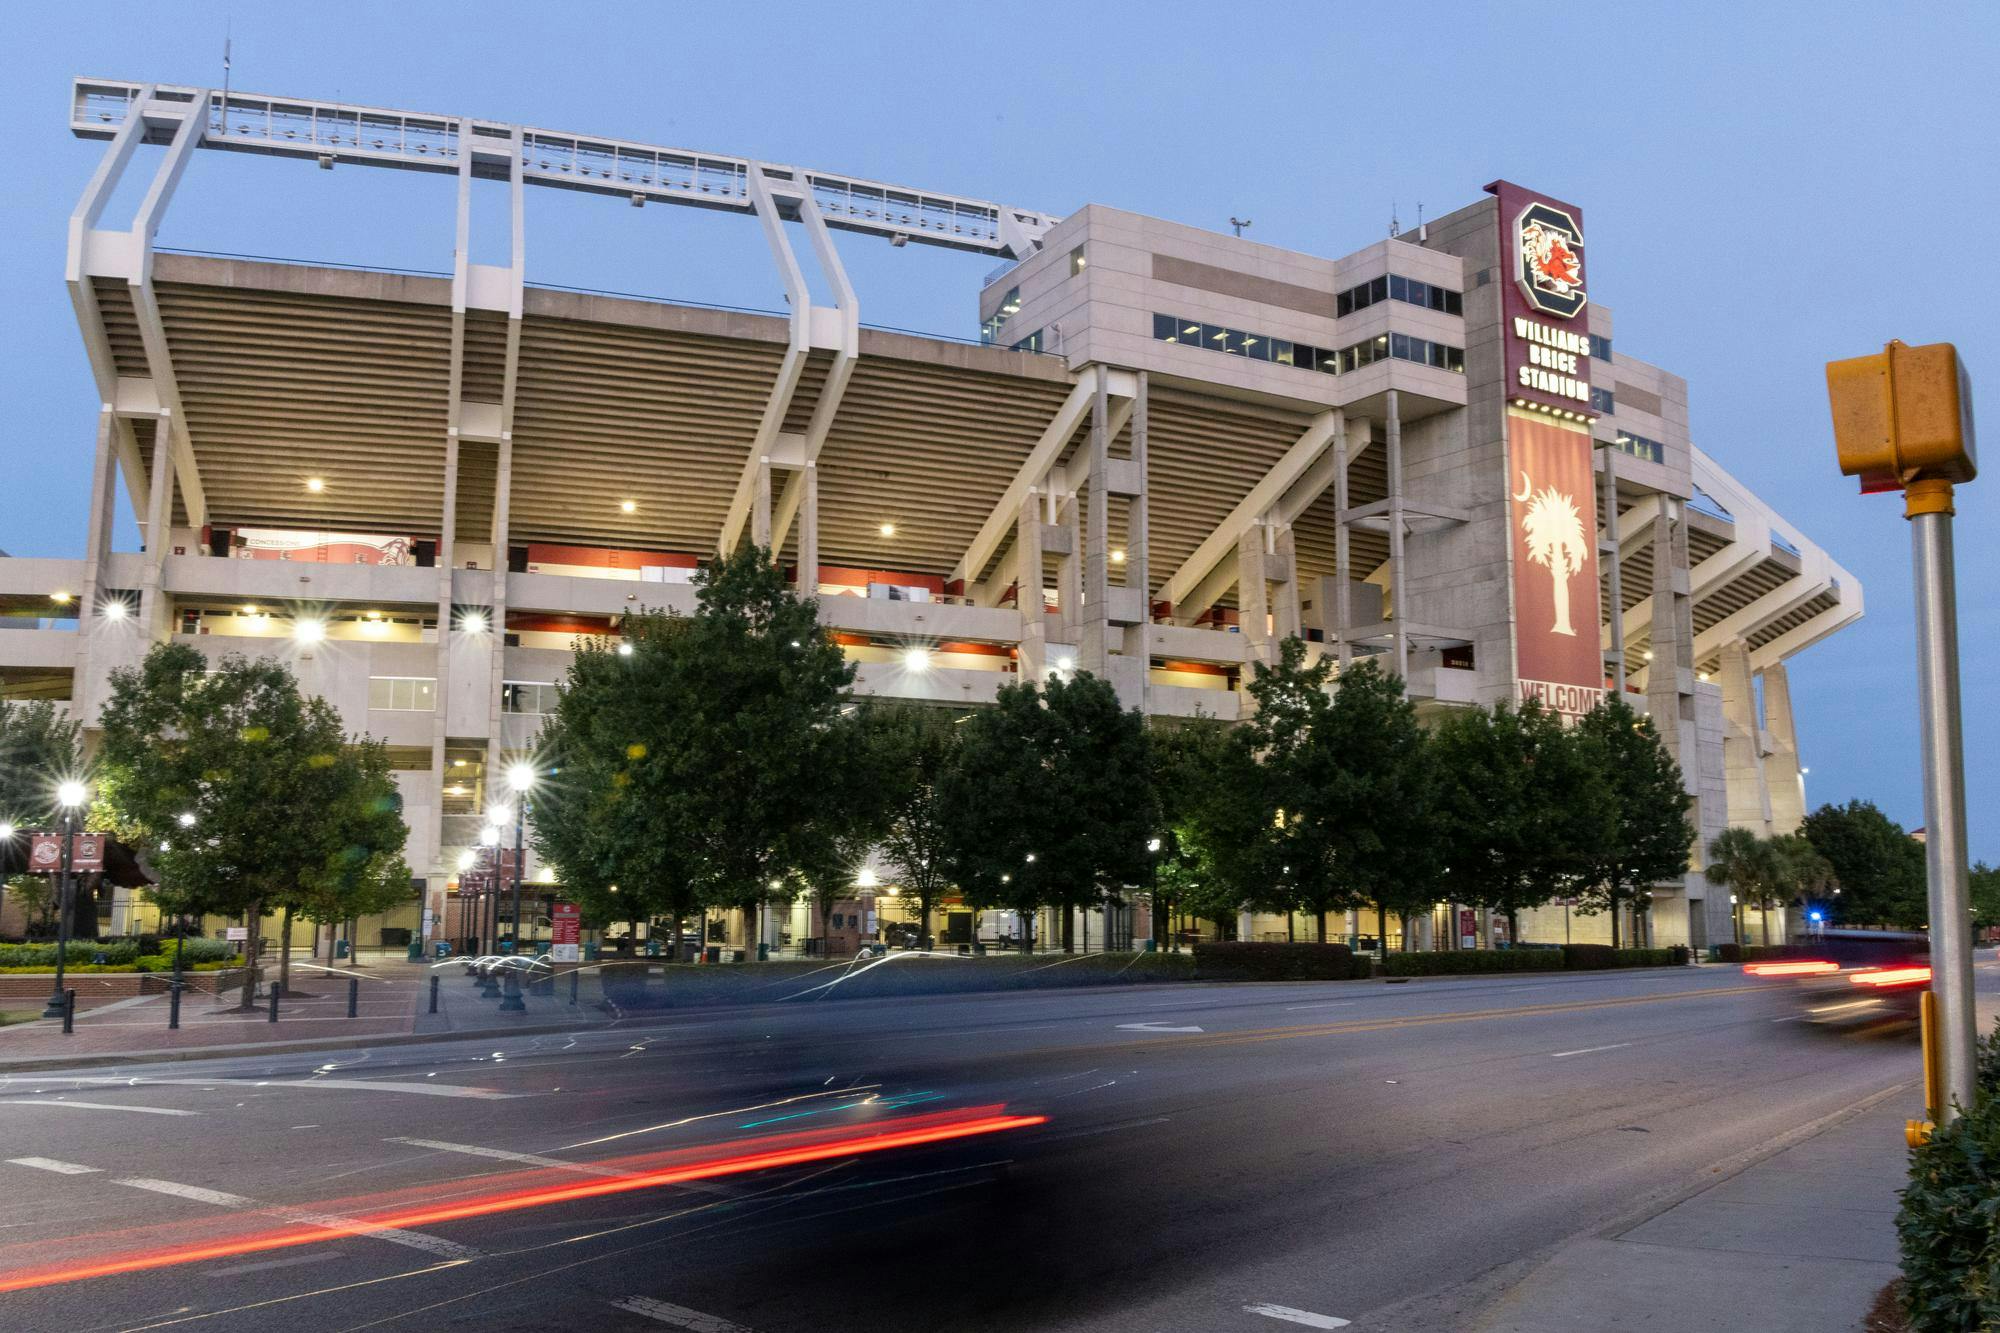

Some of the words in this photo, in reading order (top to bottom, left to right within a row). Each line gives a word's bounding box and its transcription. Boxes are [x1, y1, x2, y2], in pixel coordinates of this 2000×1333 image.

[1514, 317, 1590, 356] WILLIAMS
[1529, 344, 1577, 375] BRICE
[1519, 366, 1589, 402] STADIUM
[1520, 680, 1602, 713] WELCOME
